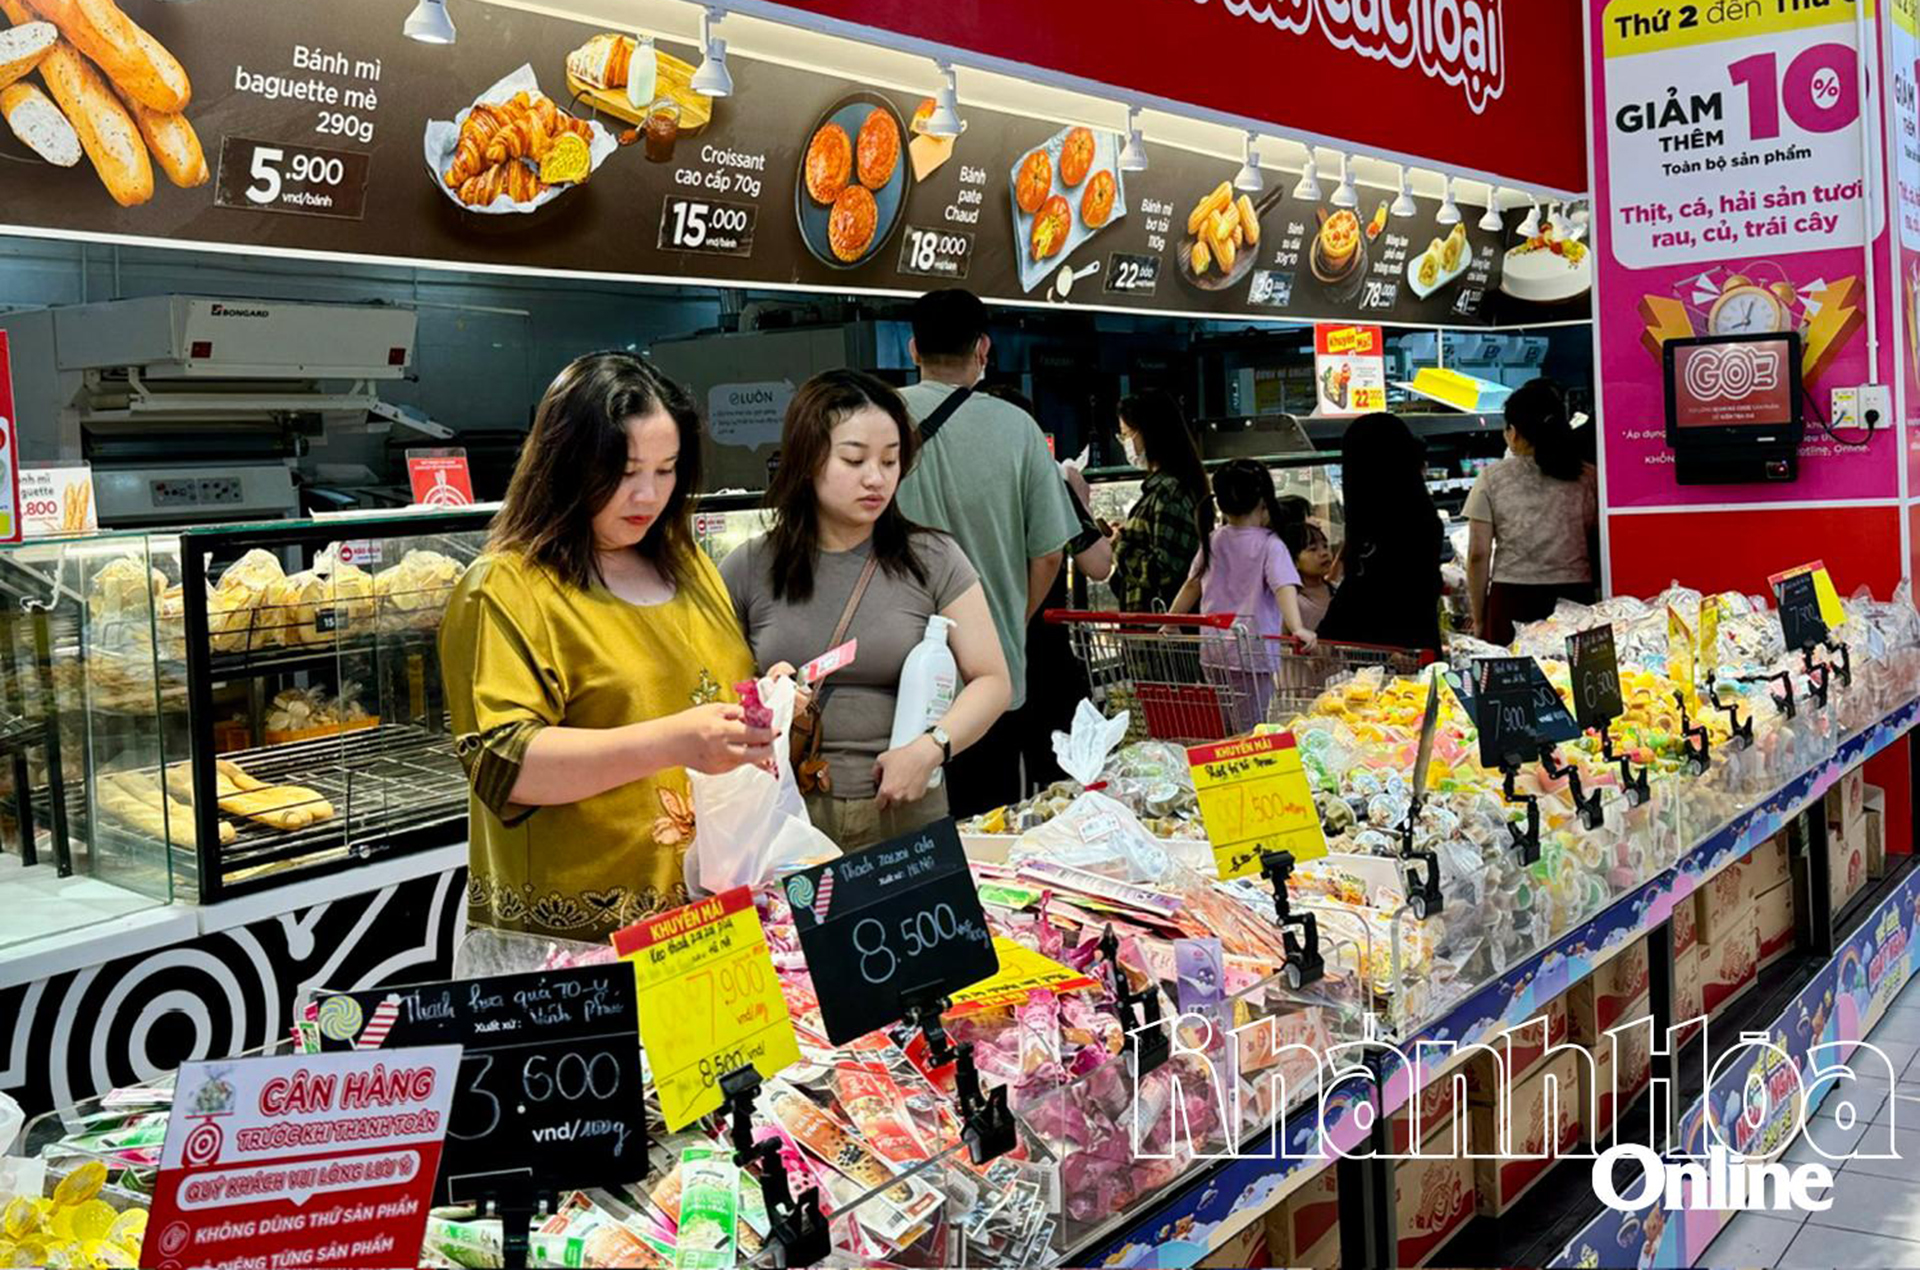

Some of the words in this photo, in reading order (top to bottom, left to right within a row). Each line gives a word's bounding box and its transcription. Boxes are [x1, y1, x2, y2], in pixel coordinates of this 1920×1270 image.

[1615, 9, 1671, 39] Thứ
[1678, 5, 1699, 28] 2
[293, 45, 349, 76] Bánh
[355, 58, 382, 82] mì
[235, 65, 339, 105] baguette
[344, 88, 378, 110] mè
[316, 111, 374, 143] 290g
[1615, 86, 1723, 134] GIẢM
[701, 144, 765, 172] Croissant
[1658, 129, 1725, 153] THÊM
[959, 166, 986, 185] Bánh
[1662, 160, 1701, 176] Toàn
[1705, 155, 1727, 171] bộ
[1731, 150, 1760, 168] sản
[1763, 145, 1812, 167] phẩm
[674, 167, 702, 186] cao
[704, 170, 732, 192] cấp
[734, 174, 762, 198] 70g
[957, 188, 983, 205] pate
[944, 205, 979, 224] Chaud
[1620, 205, 1673, 226] Thịt,
[1679, 196, 1713, 218] cá,
[1720, 189, 1757, 214] hải
[1763, 186, 1806, 208] sản
[1813, 178, 1864, 201] tươi
[672, 201, 747, 247] 15.000
[1652, 229, 1697, 248] rau,
[1703, 219, 1738, 243] củ,
[1745, 216, 1788, 238] trái
[1794, 212, 1839, 235] cây
[222, 308, 269, 318] BONGARD
[650, 903, 701, 943] KHUYẾN
[702, 896, 726, 926] MÃI
[259, 1069, 334, 1117] CÂN
[338, 1062, 437, 1110] HÀNG
[237, 1121, 302, 1152] TRƯỚC
[301, 1120, 333, 1145] KHI
[333, 1114, 396, 1143] THANH
[395, 1107, 440, 1135] TOÁN
[184, 1174, 227, 1203] QUÝ
[225, 1169, 286, 1199] KHÁCH
[288, 1165, 318, 1190] VUI
[319, 1161, 365, 1186] LÒNG
[195, 1219, 255, 1245] KHÔNG
[258, 1213, 305, 1236] DÙNG
[343, 1202, 373, 1223] SẢN
[376, 1193, 419, 1216] PHẨM
[271, 1249, 313, 1268] TỪNG
[317, 1240, 349, 1260] SẢN
[351, 1233, 394, 1256] PHẨM
